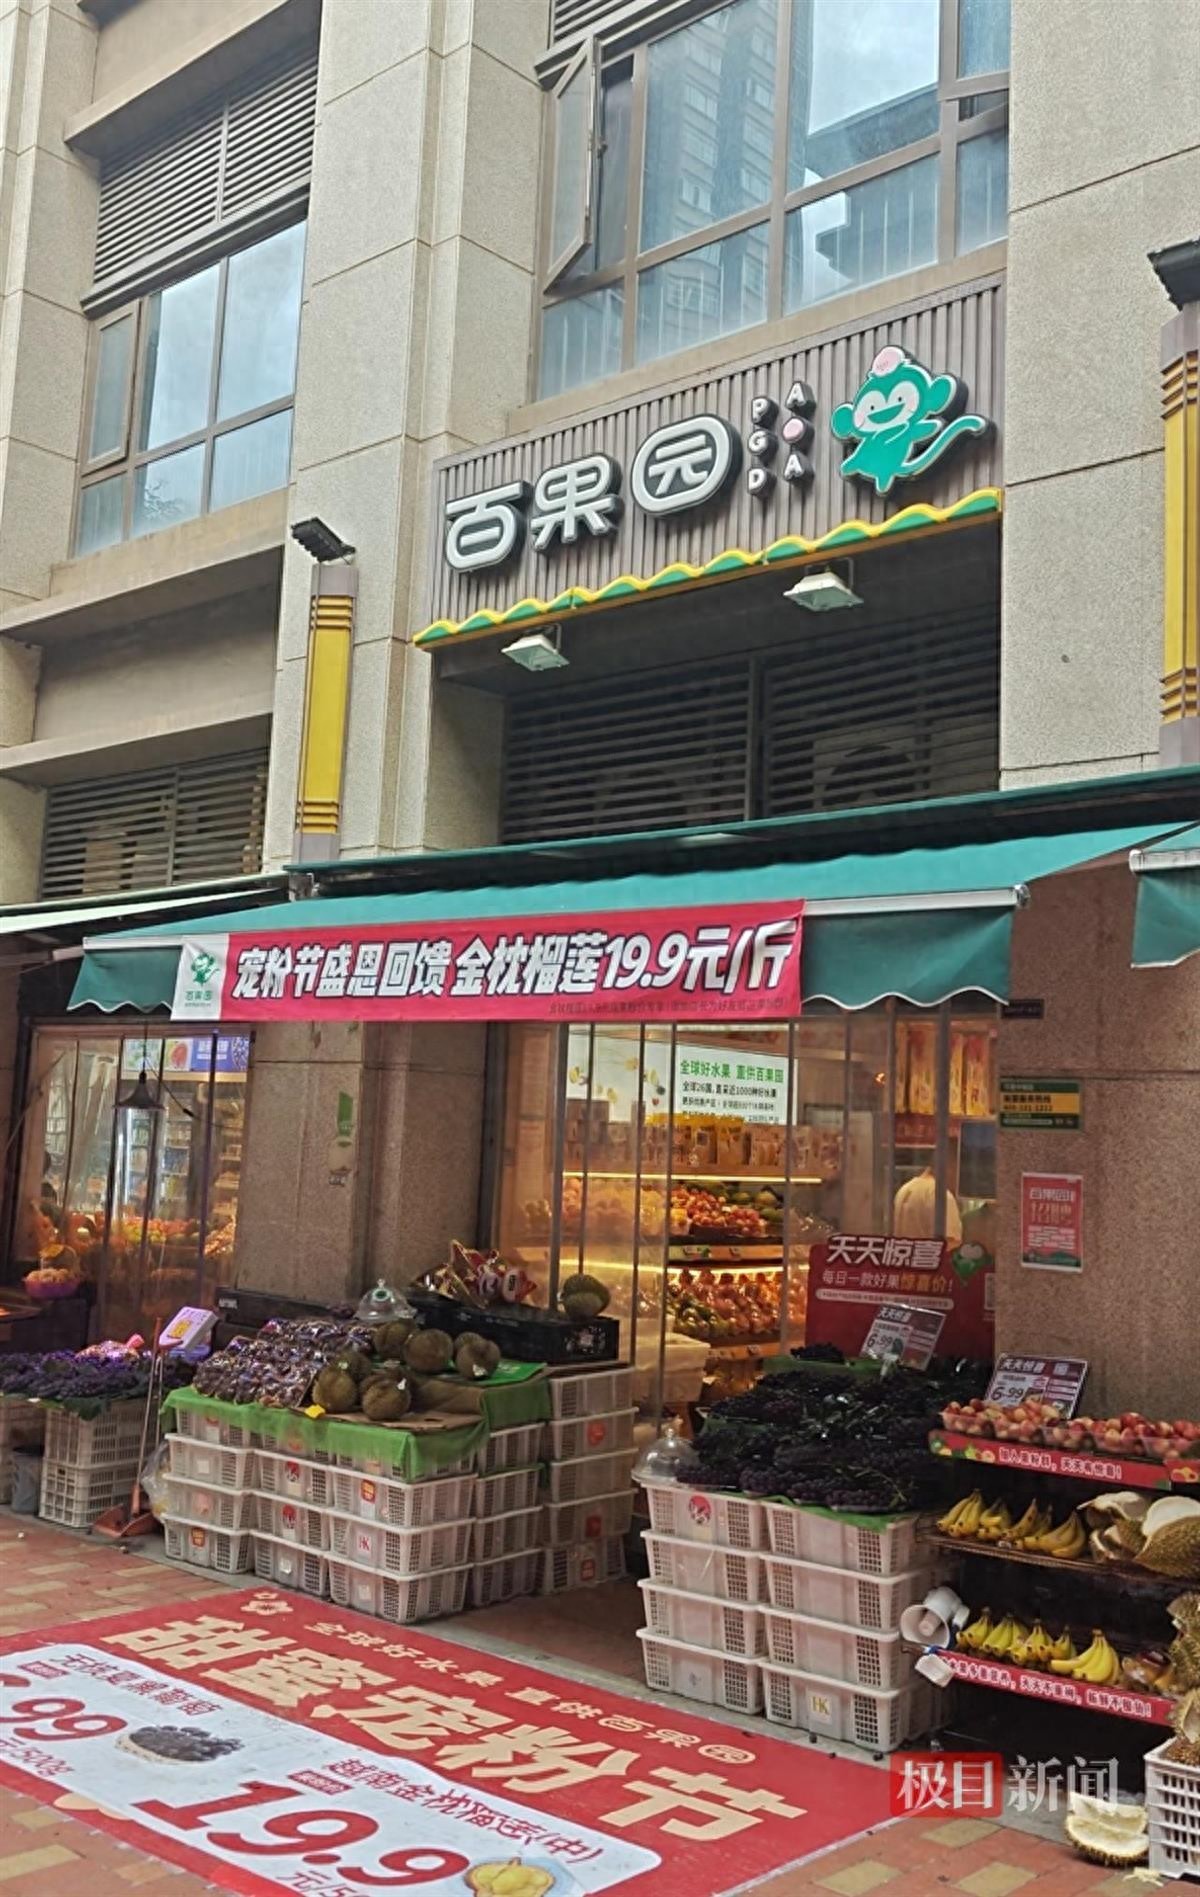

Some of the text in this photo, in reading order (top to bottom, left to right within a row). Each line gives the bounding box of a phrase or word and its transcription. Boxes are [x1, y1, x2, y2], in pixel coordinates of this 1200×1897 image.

[445, 414, 736, 574] 百果园
[231, 919, 797, 999] 宠粉节盛恩回馈 金枕榴莲19.9元/斤
[680, 1059, 730, 1078] 全球好水果
[827, 1235, 944, 1269] 天天惊喜
[101, 1615, 807, 1841] 甜蜜宠粉节
[304, 1621, 756, 1764] 全球好水果 直供百果园
[812, 1696, 830, 1716] HK
[131, 1780, 470, 1887] 19.9
